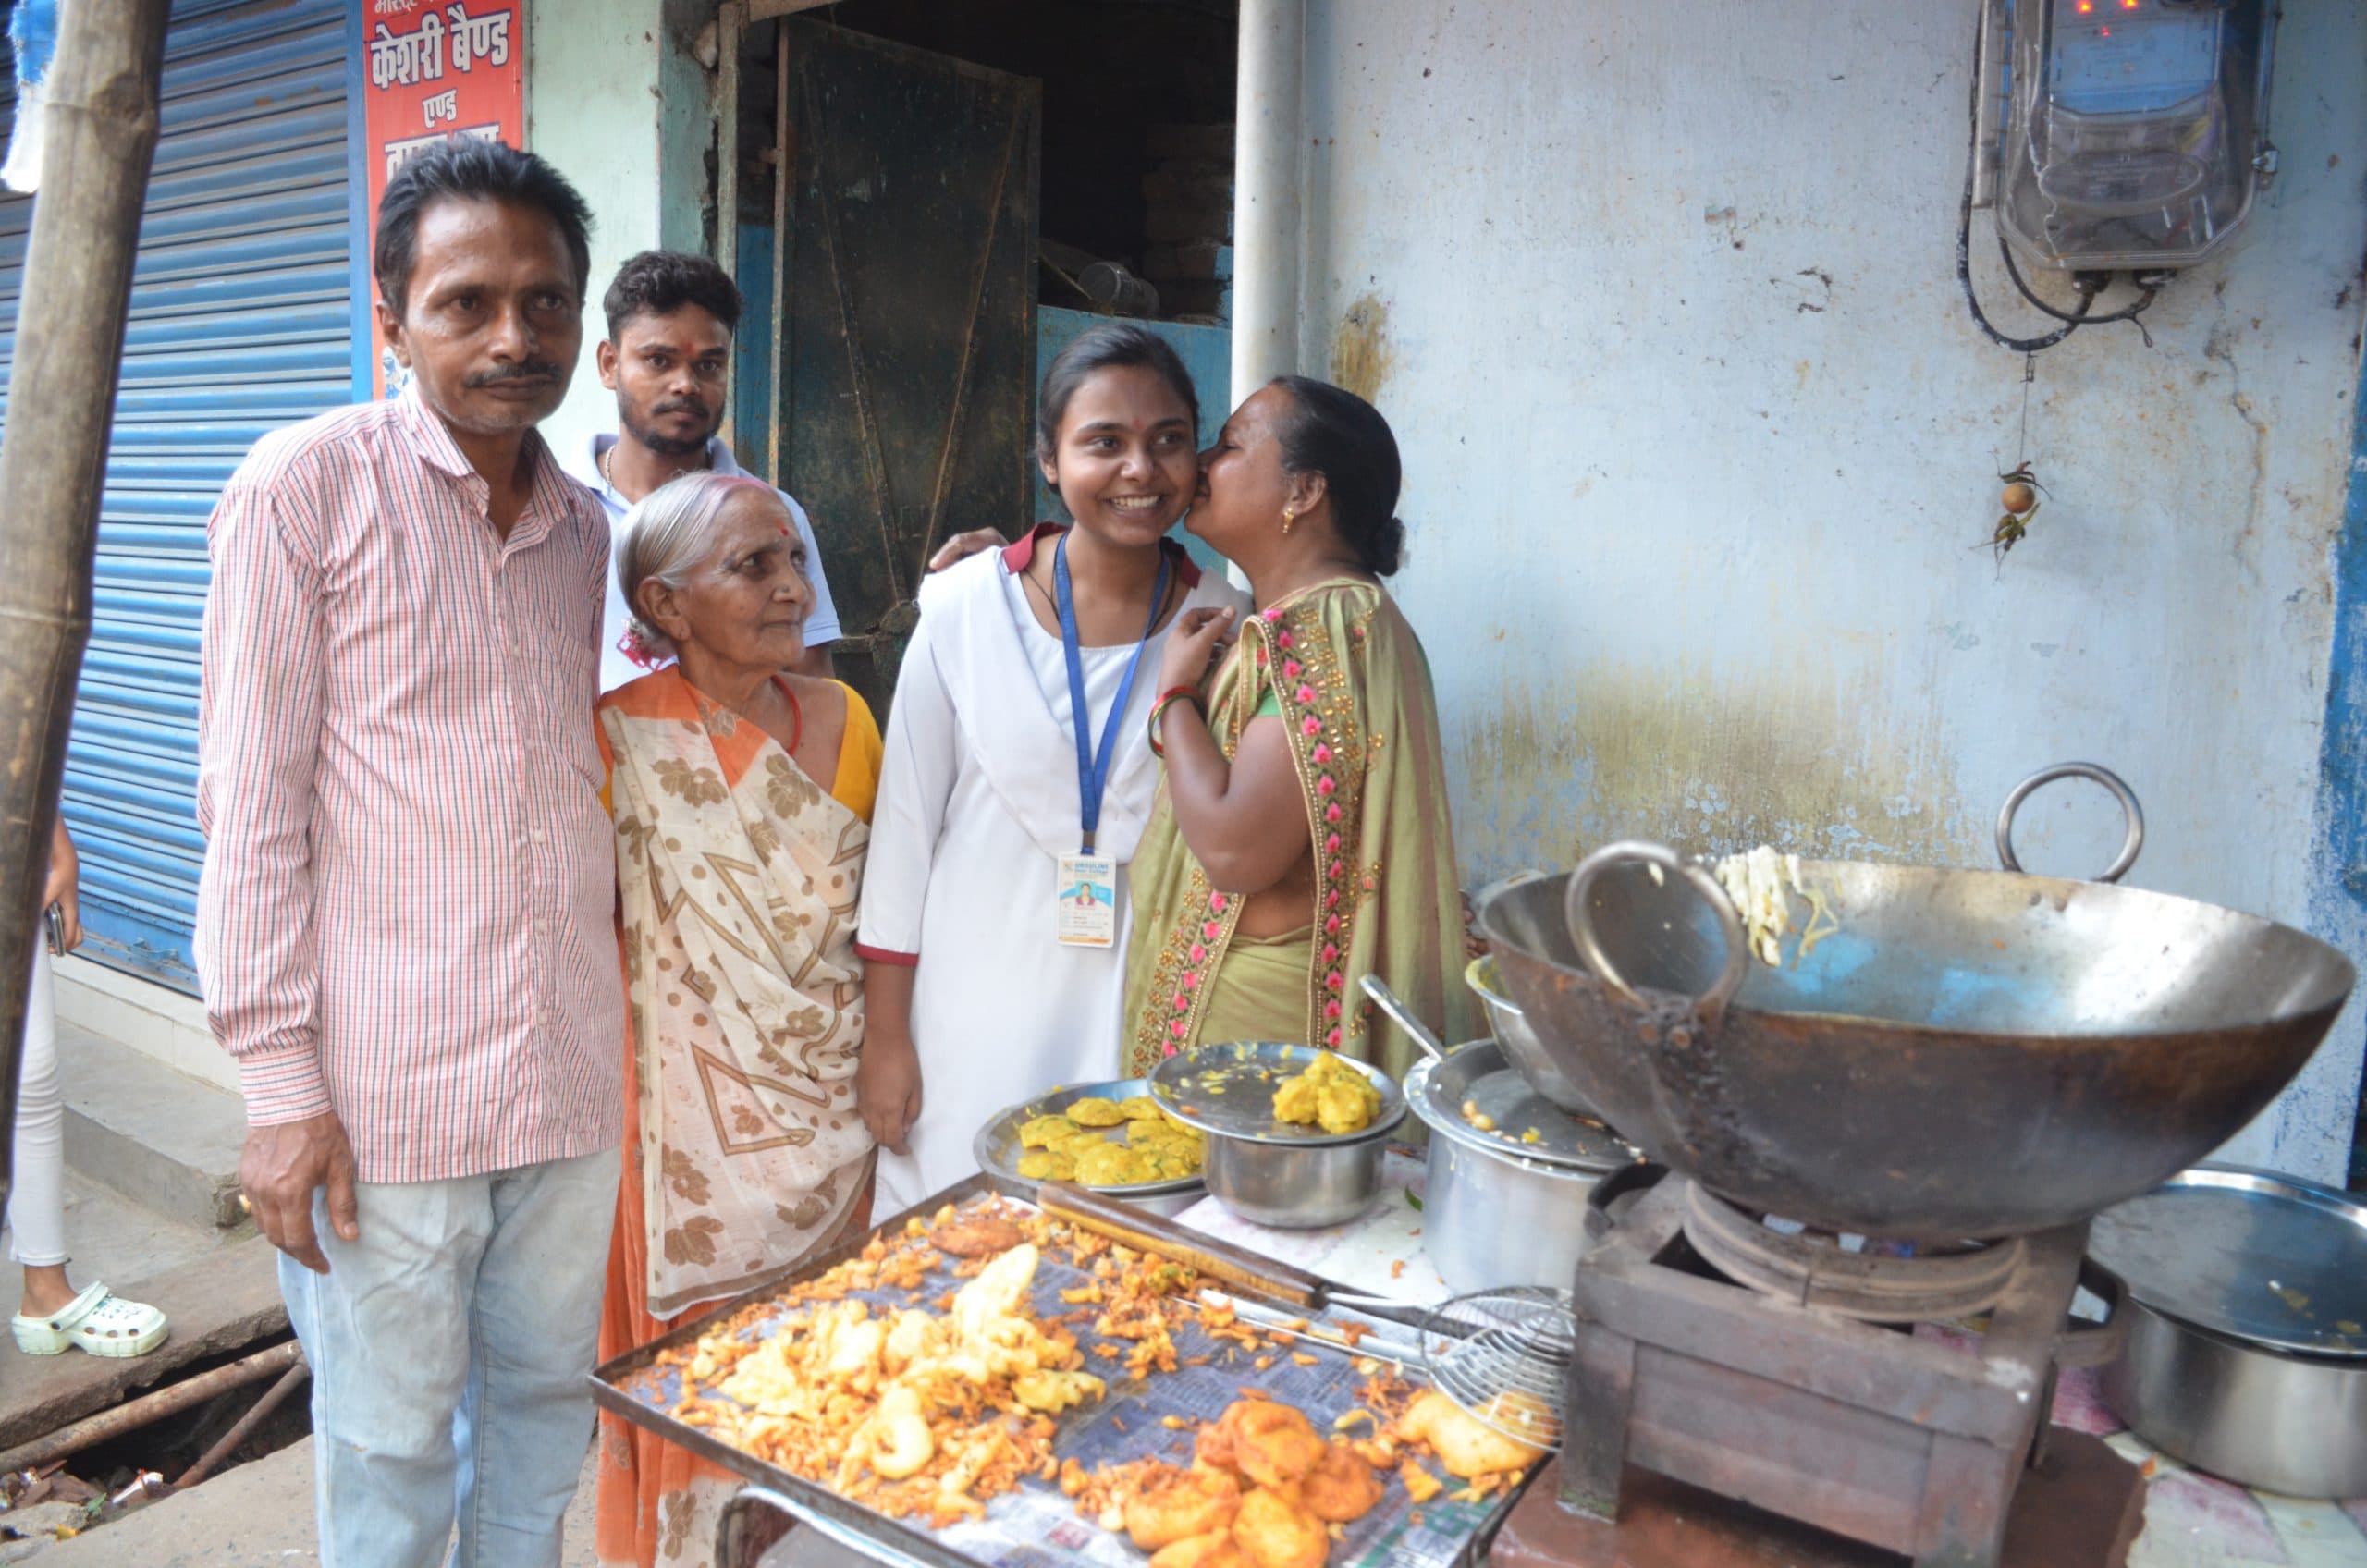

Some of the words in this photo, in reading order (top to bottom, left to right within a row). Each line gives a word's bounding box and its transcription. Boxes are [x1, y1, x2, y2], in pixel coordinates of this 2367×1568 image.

[370, 11, 445, 90] केशरी
[447, 3, 511, 72] बैण्ड
[422, 89, 457, 129] एण्ड
